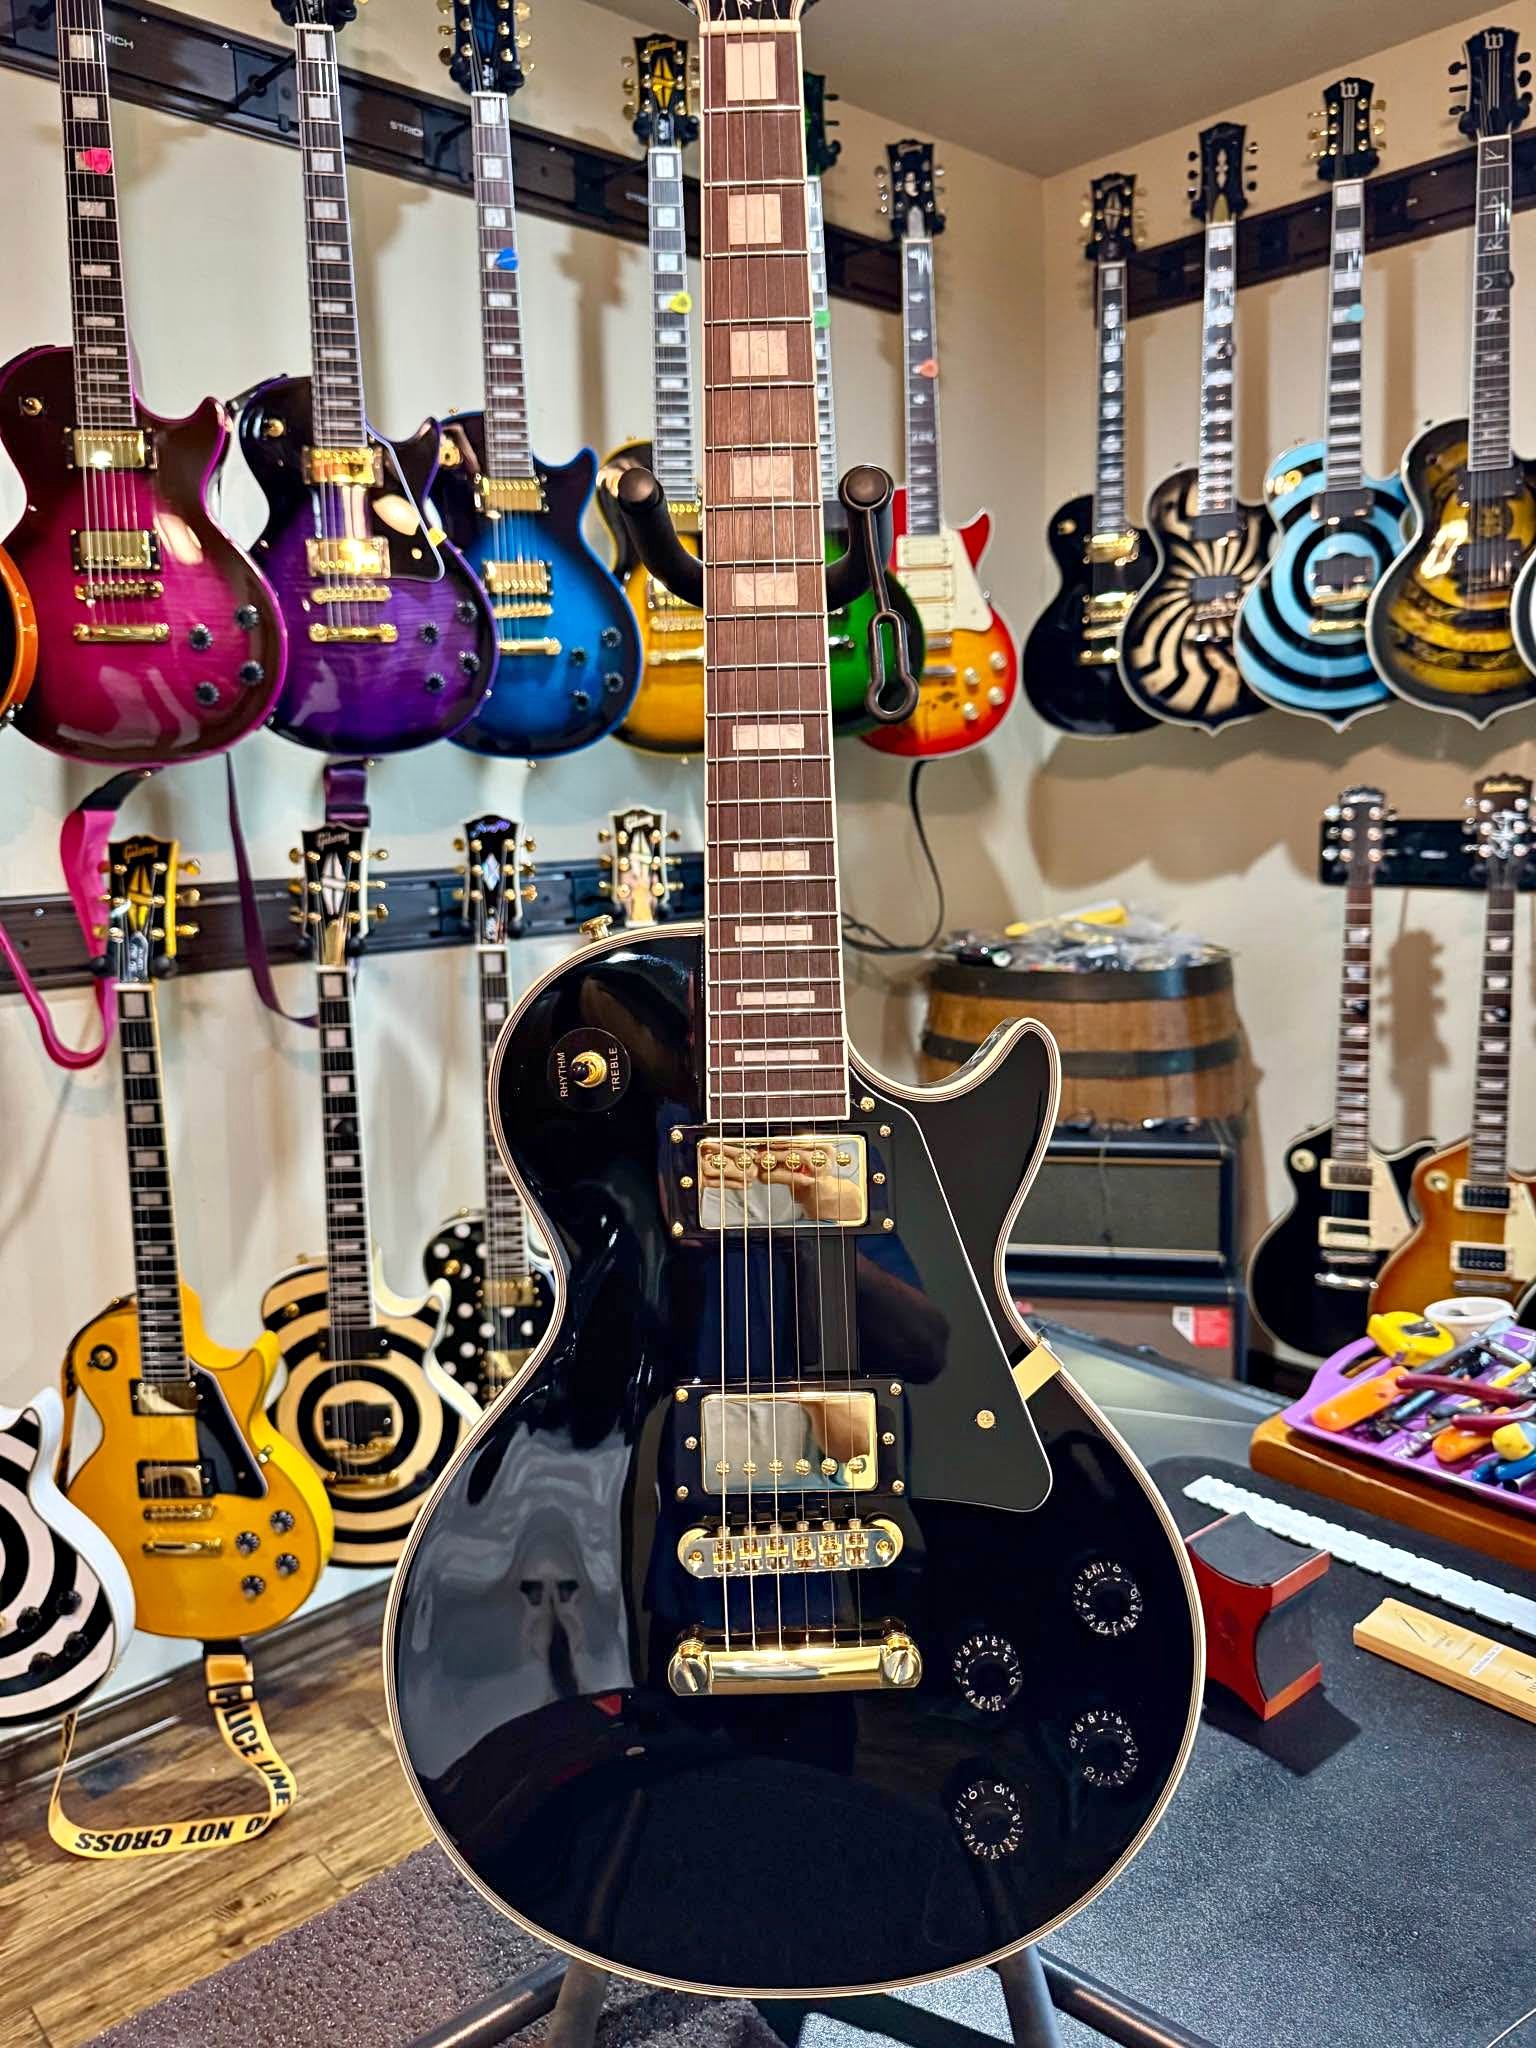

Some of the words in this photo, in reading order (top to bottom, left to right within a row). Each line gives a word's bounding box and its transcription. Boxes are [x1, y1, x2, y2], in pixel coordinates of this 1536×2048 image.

[557, 1052, 569, 1097] RHYTHM
[609, 1047, 621, 1093] TREBLE
[215, 1686, 264, 1757] PLICE
[255, 1761, 291, 1807] LINE
[75, 1828, 173, 1852] CROSS
[181, 1820, 235, 1845] NOT
